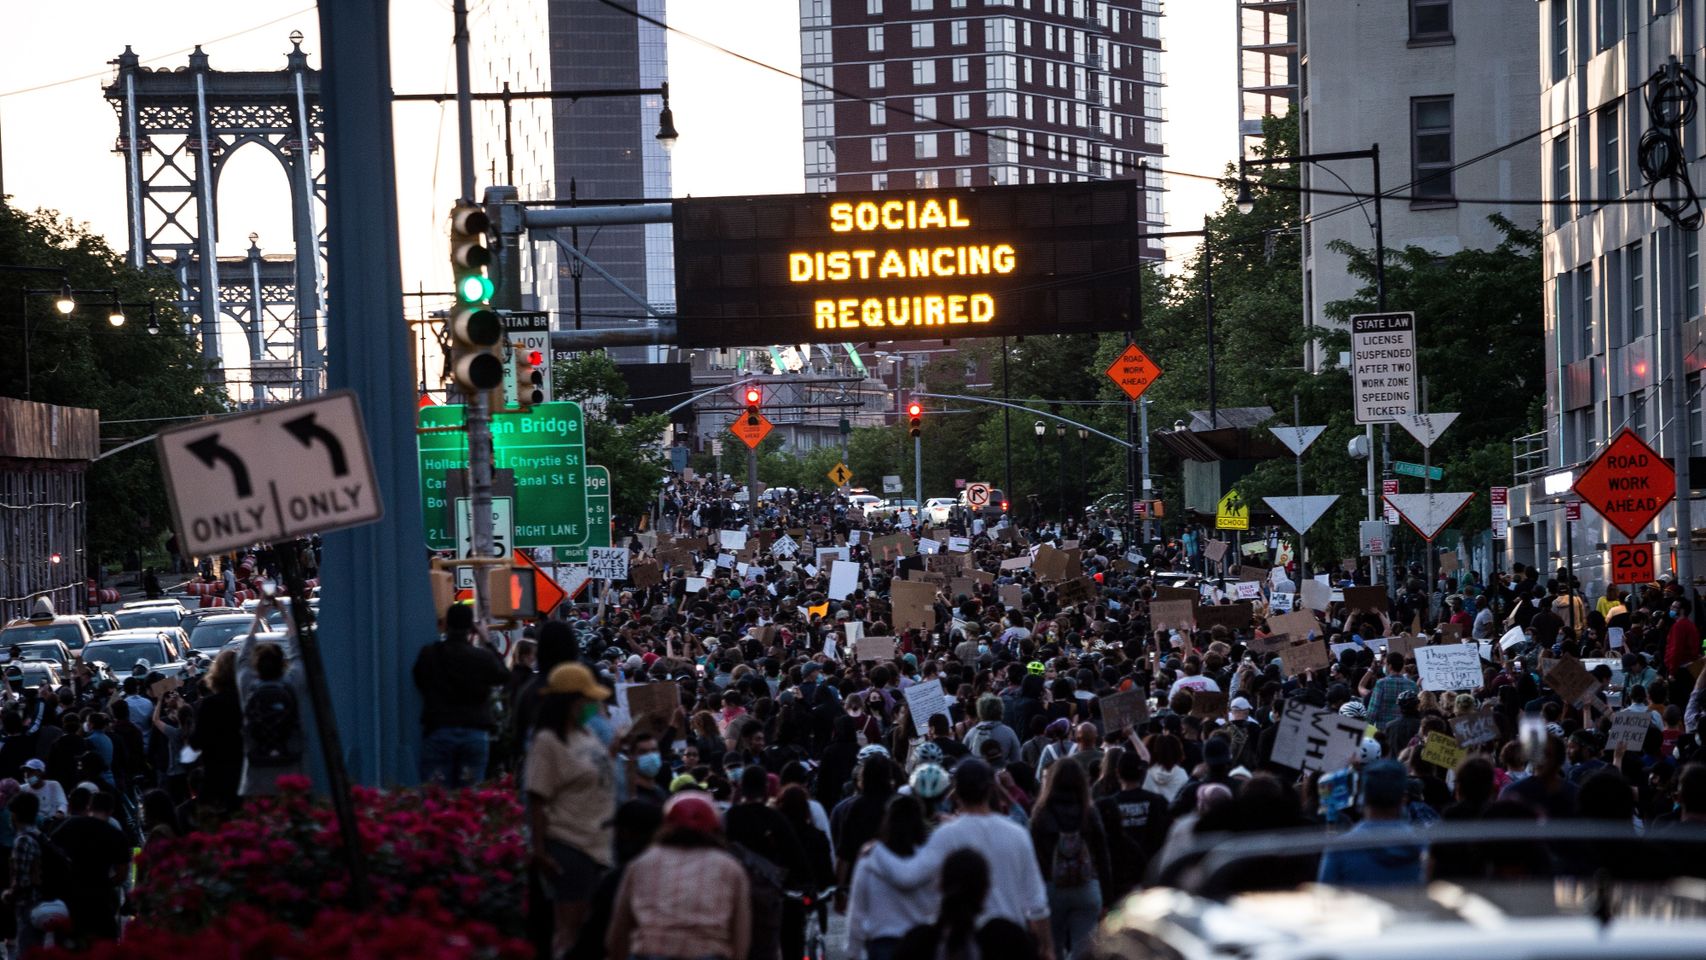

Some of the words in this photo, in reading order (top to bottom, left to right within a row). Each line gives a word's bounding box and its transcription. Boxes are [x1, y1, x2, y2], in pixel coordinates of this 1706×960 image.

[828, 198, 970, 232] SOCIAL
[788, 244, 1016, 282] DISTANCING
[814, 293, 995, 330] REQUIRED
[533, 316, 547, 326] BR
[1356, 319, 1385, 329] STATE
[1388, 318, 1409, 328] LAW
[1363, 335, 1404, 345] LICENSE
[1123, 355, 1144, 363] ROAD
[1356, 349, 1411, 360] SUSPENDED
[1358, 364, 1388, 374] AFTER
[1391, 363, 1411, 372] TWO
[1361, 379, 1386, 388] WORK
[1387, 377, 1409, 387] ZONE
[1362, 392, 1410, 402] SPEEDING
[1366, 406, 1406, 416] TICKETS
[521, 418, 578, 437] Bridge
[510, 456, 561, 469] Chrystie
[566, 455, 578, 465] St
[1607, 454, 1649, 469] ROAD
[551, 474, 564, 485] St
[568, 474, 576, 484] E
[1608, 476, 1649, 491] WORK
[1606, 497, 1657, 513] AHEAD
[191, 506, 265, 542] ONLY
[289, 485, 361, 521] ONLY
[514, 525, 546, 536] RIGHT
[551, 524, 579, 536] LANE
[592, 549, 625, 560] BLACK
[1617, 549, 1648, 568] 20
[591, 559, 625, 568] LIVES
[588, 566, 628, 578] MATTER
